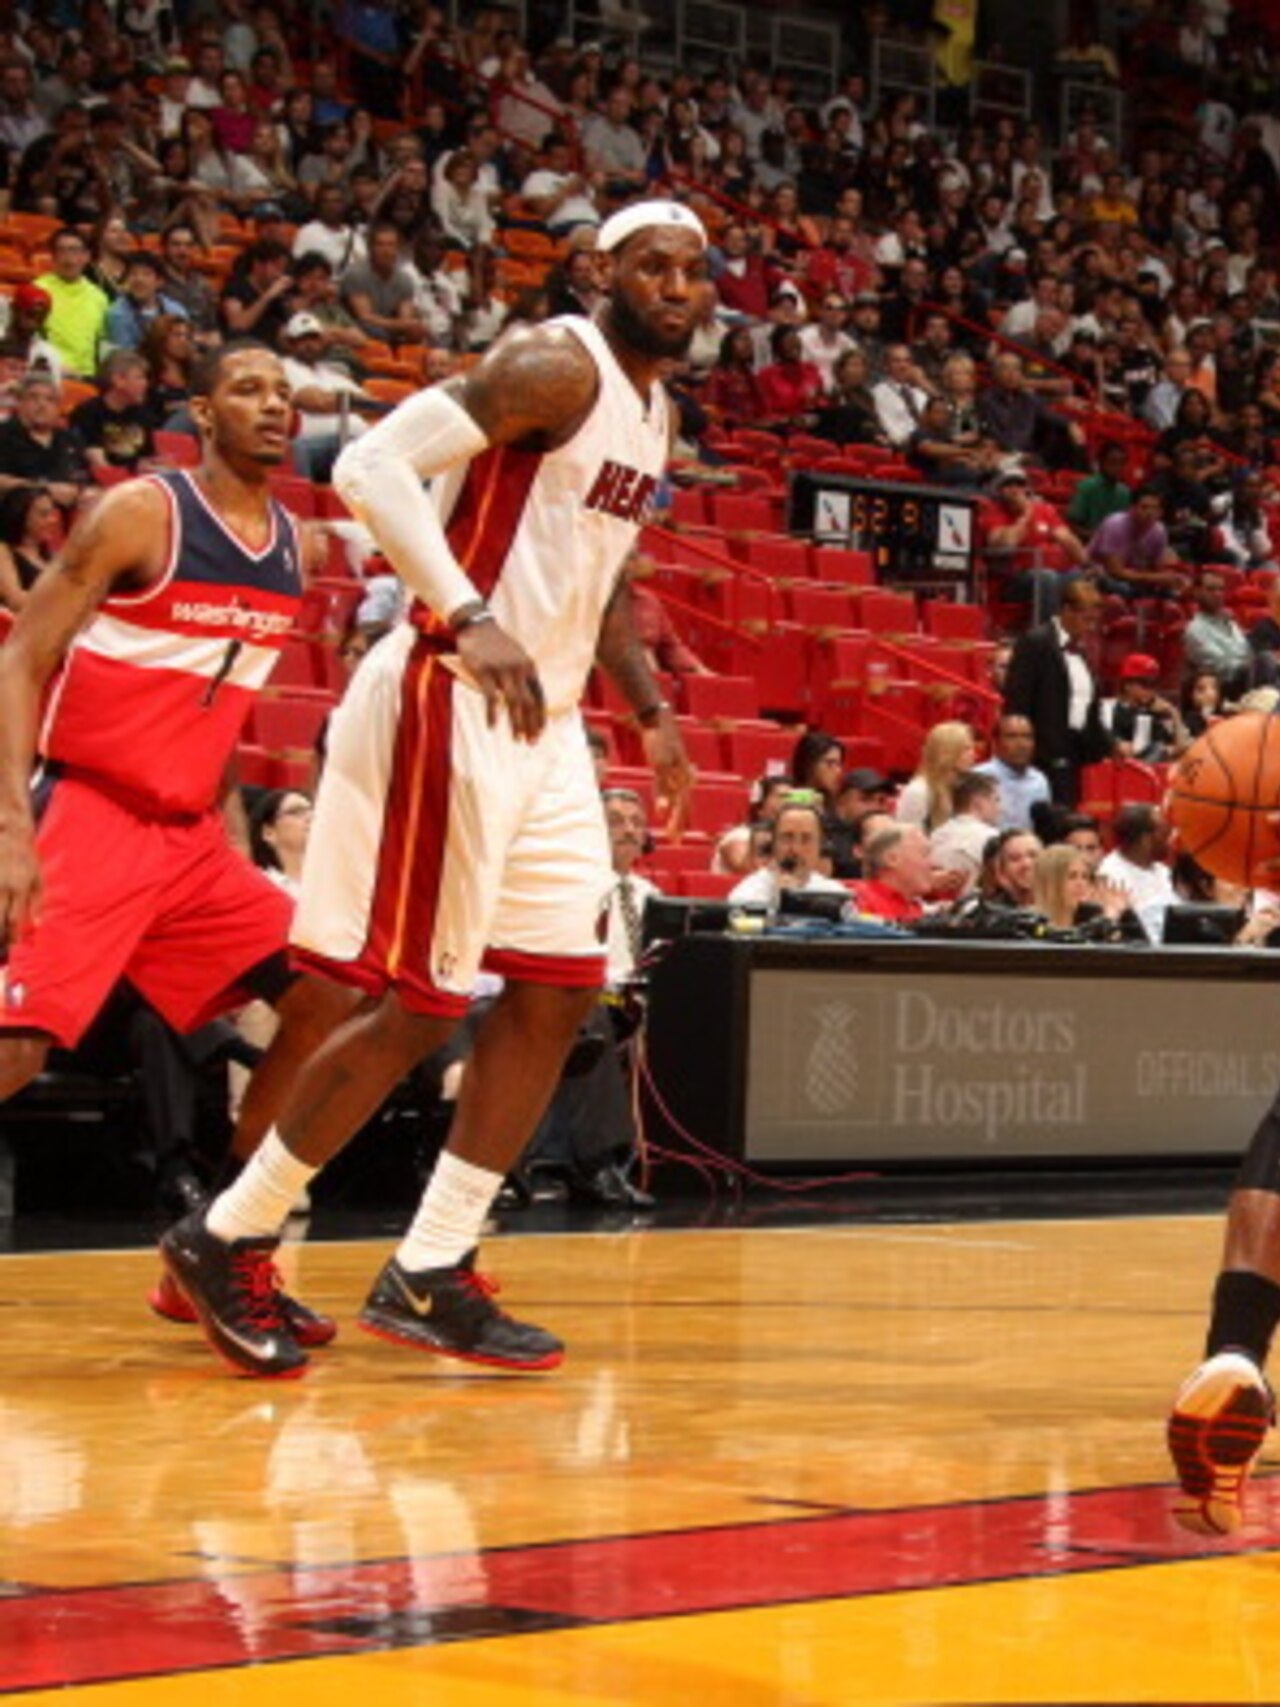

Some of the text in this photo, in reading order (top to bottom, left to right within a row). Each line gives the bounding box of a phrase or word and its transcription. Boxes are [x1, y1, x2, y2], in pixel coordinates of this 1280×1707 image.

[585, 460, 657, 524] HEA
[201, 638, 243, 708] 1
[896, 989, 1076, 1053] Doctors
[891, 1063, 1088, 1142] Hospital
[1137, 1049, 1261, 1096] OFFICIAL
